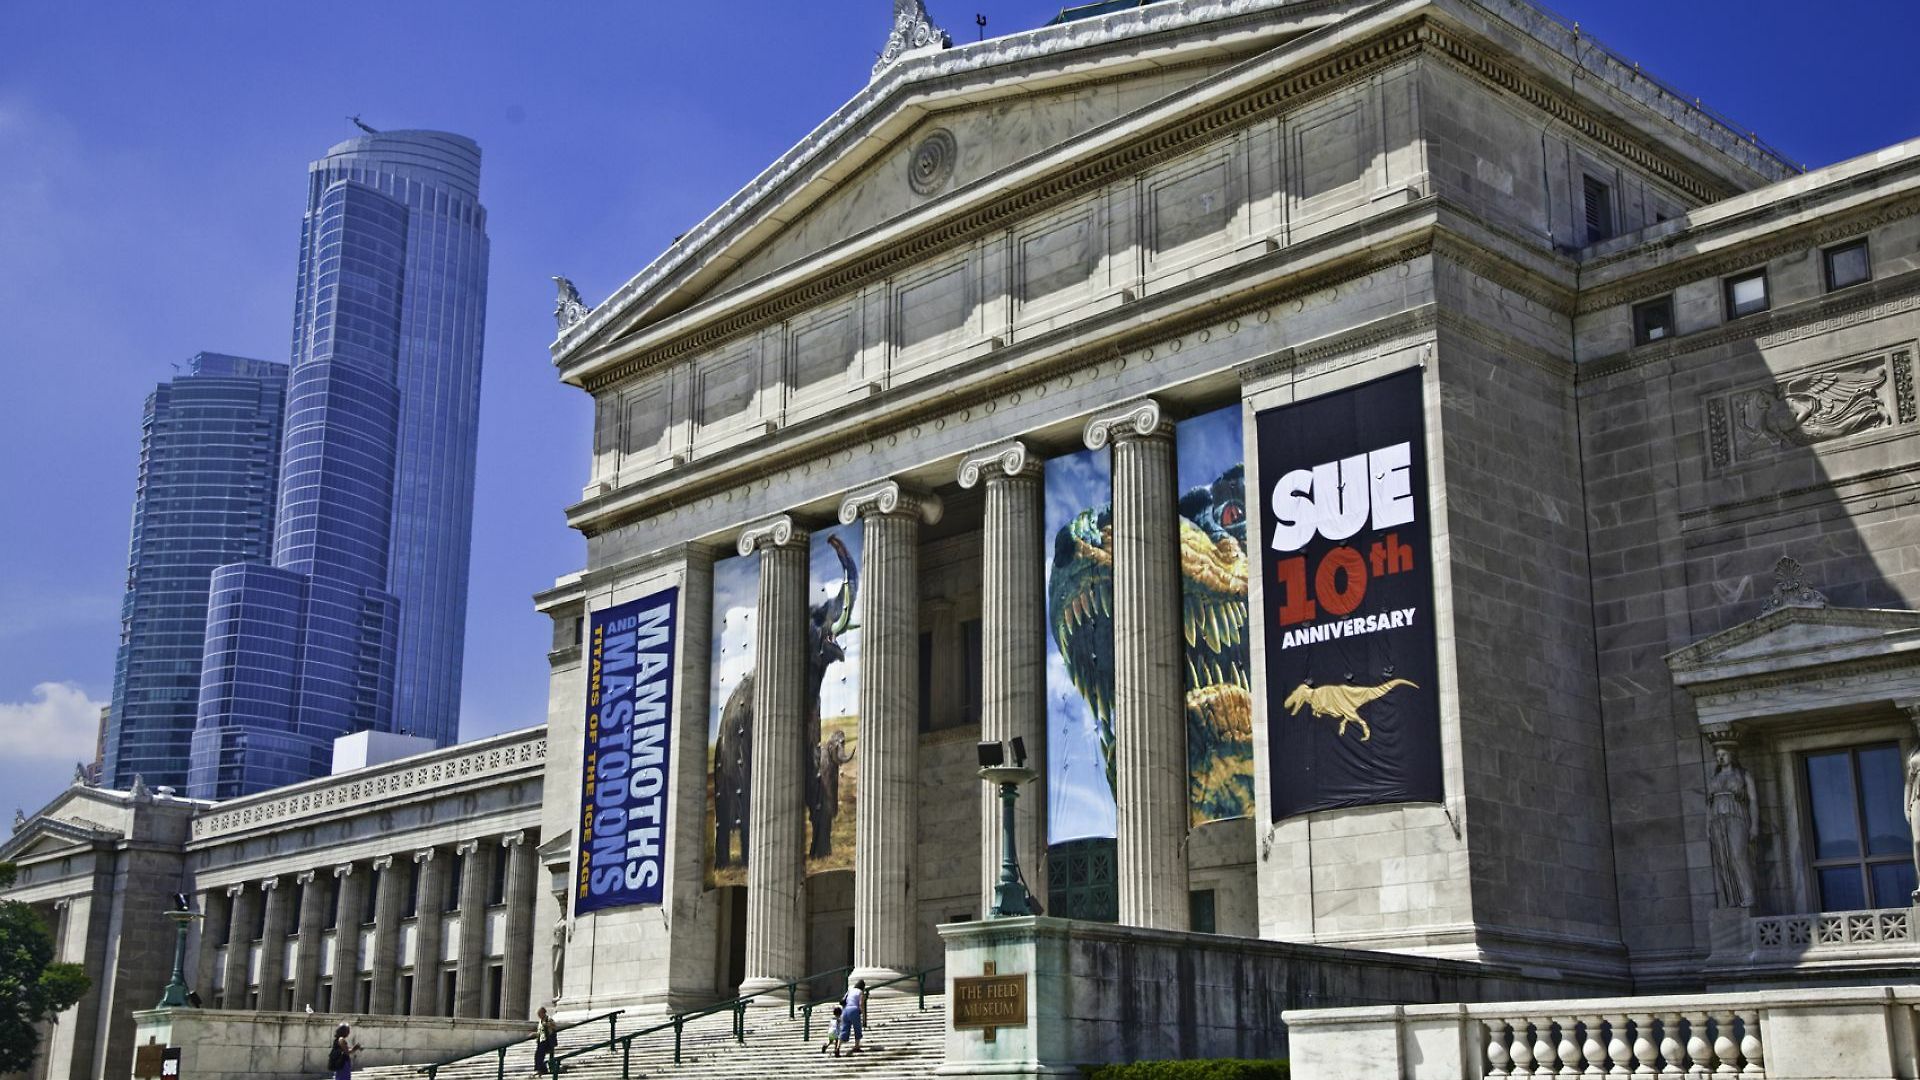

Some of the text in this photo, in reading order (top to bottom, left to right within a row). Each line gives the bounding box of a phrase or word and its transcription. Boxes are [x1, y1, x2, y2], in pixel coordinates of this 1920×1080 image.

[1271, 441, 1415, 552] SUE
[607, 615, 637, 635] AND
[1277, 532, 1414, 627] 10th
[1281, 607, 1416, 650] ANNIVERSARY
[579, 624, 603, 899] TITANS OF THE ICE AGE
[591, 630, 637, 896] MASTODONS
[625, 602, 671, 890] MAMMOTHS
[960, 983, 1019, 1000] THE FIELD
[964, 1001, 1014, 1016] MUSEUM
